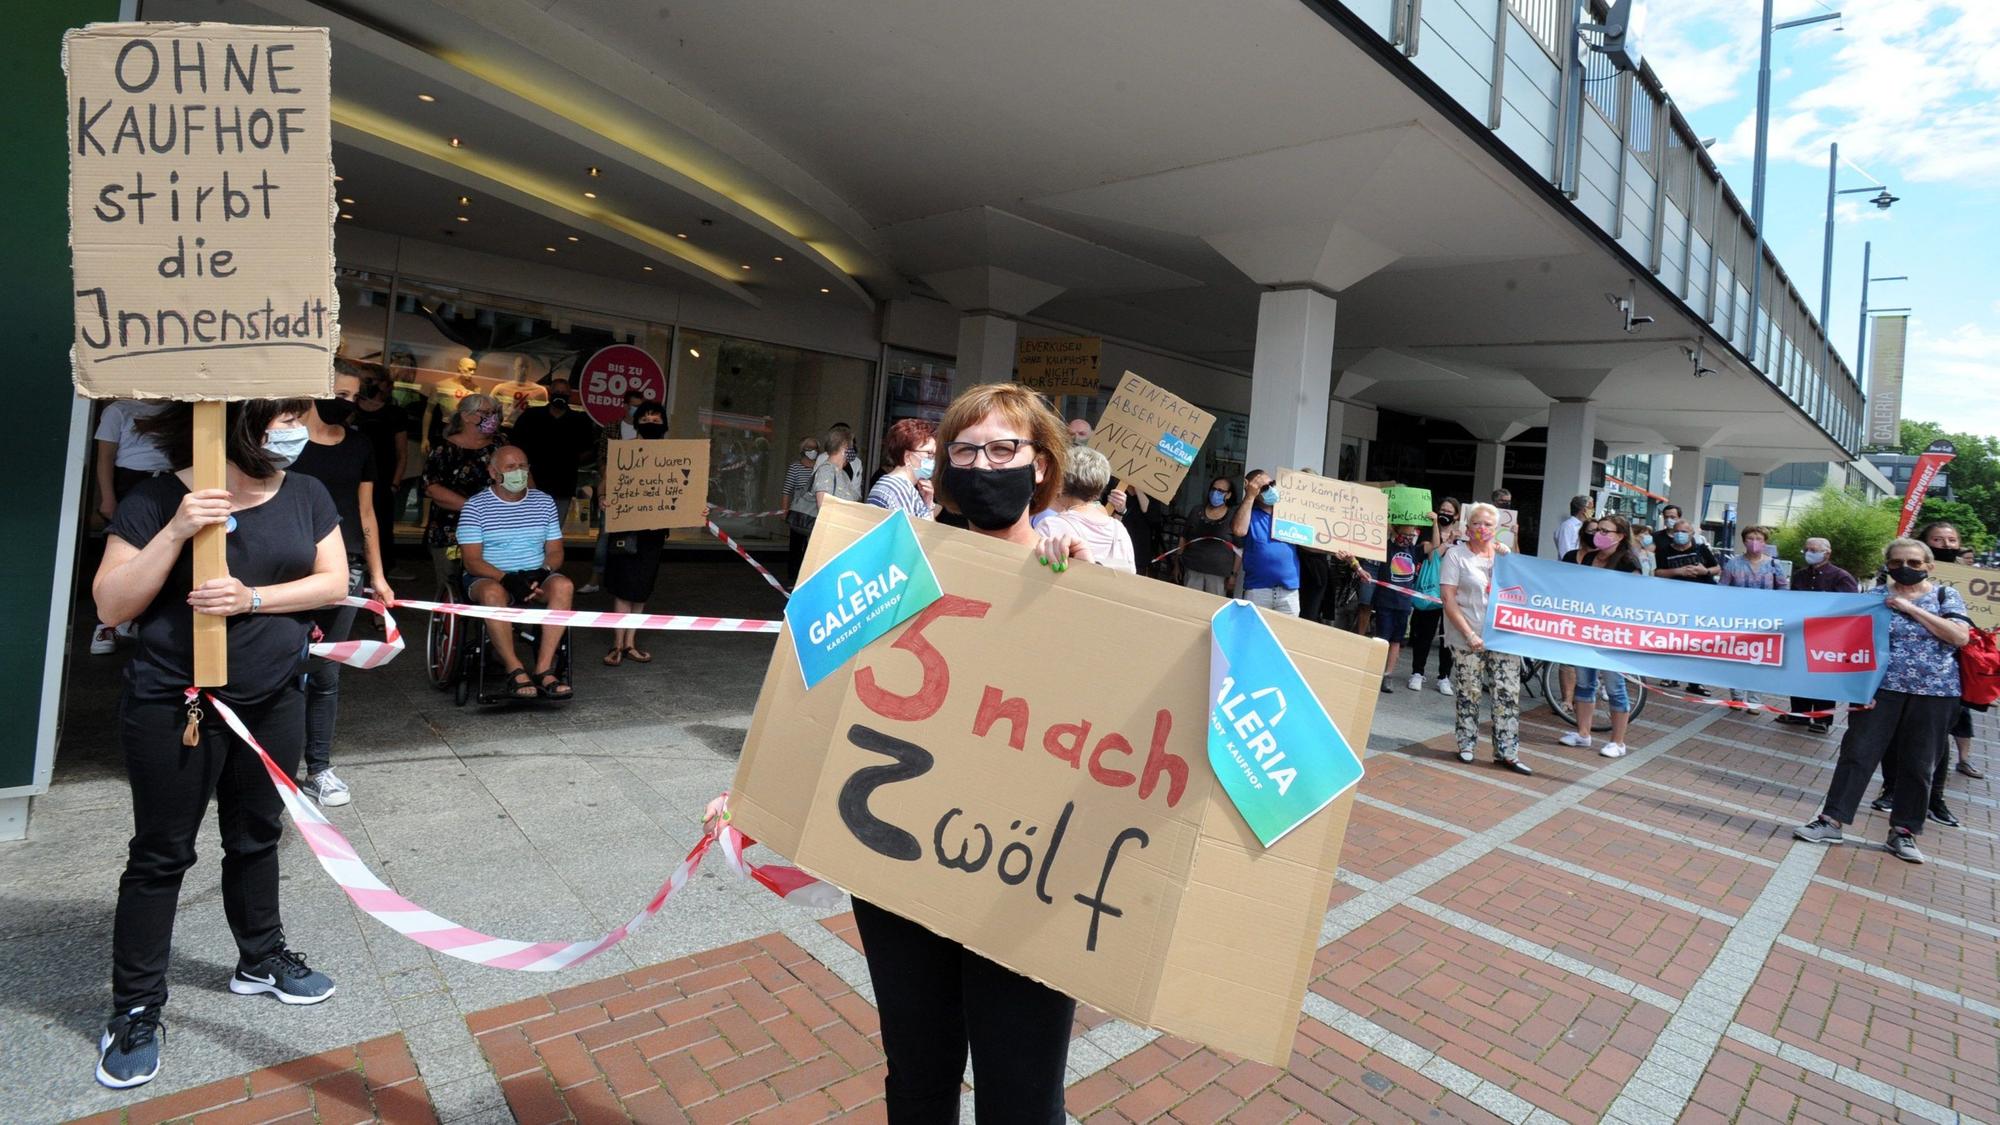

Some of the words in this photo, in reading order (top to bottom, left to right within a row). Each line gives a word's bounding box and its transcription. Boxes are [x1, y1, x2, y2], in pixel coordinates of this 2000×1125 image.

[114, 38, 301, 95] OHNE
[76, 97, 306, 156] KAUFHOF
[93, 169, 280, 225] stirbt
[157, 235, 237, 278] die
[589, 371, 656, 400] 50%
[608, 363, 624, 374] BIS
[628, 366, 643, 376] ZU
[1045, 368, 1079, 378] NICHT
[1111, 395, 1200, 445] ABSERVIERT
[1124, 378, 1200, 424] EINFACH
[1873, 392, 1894, 440] GALERIA
[617, 447, 649, 471] Wir
[654, 456, 692, 468] waren
[1095, 423, 1155, 458] NICHT
[1158, 439, 1193, 463] GALERIA
[611, 487, 640, 505] jetzt
[643, 486, 660, 498] seid
[664, 485, 684, 496] bitte
[615, 474, 634, 491] für
[638, 473, 663, 486] euch
[1280, 473, 1308, 490] Wir
[1310, 481, 1359, 504] kämpfen
[1905, 464, 1935, 512] BRATWURST
[613, 503, 631, 520] für
[637, 504, 653, 513] uns
[1277, 509, 1306, 524] und
[1315, 517, 1382, 546] JOBS
[1301, 498, 1335, 513] unsere
[1341, 505, 1385, 525] Filiale
[809, 564, 909, 645] GALERIA
[826, 622, 863, 652] KARSTADT
[865, 593, 902, 623] KAUFHOF
[1530, 594, 1596, 615] GALERIA
[1601, 604, 1690, 626] KARSTADT
[1694, 615, 1784, 631] KAUFHOF
[1499, 609, 1576, 638] Zukunft
[1581, 623, 1632, 646] statt
[1639, 629, 1774, 666] Kahlschlag!
[1809, 648, 1870, 665] ver.di
[854, 593, 991, 722] 5
[971, 686, 1190, 807] nach
[1217, 676, 1298, 797] ALERIA
[1226, 741, 1263, 790] KAUFHOF
[838, 723, 1149, 952] Zwölf
